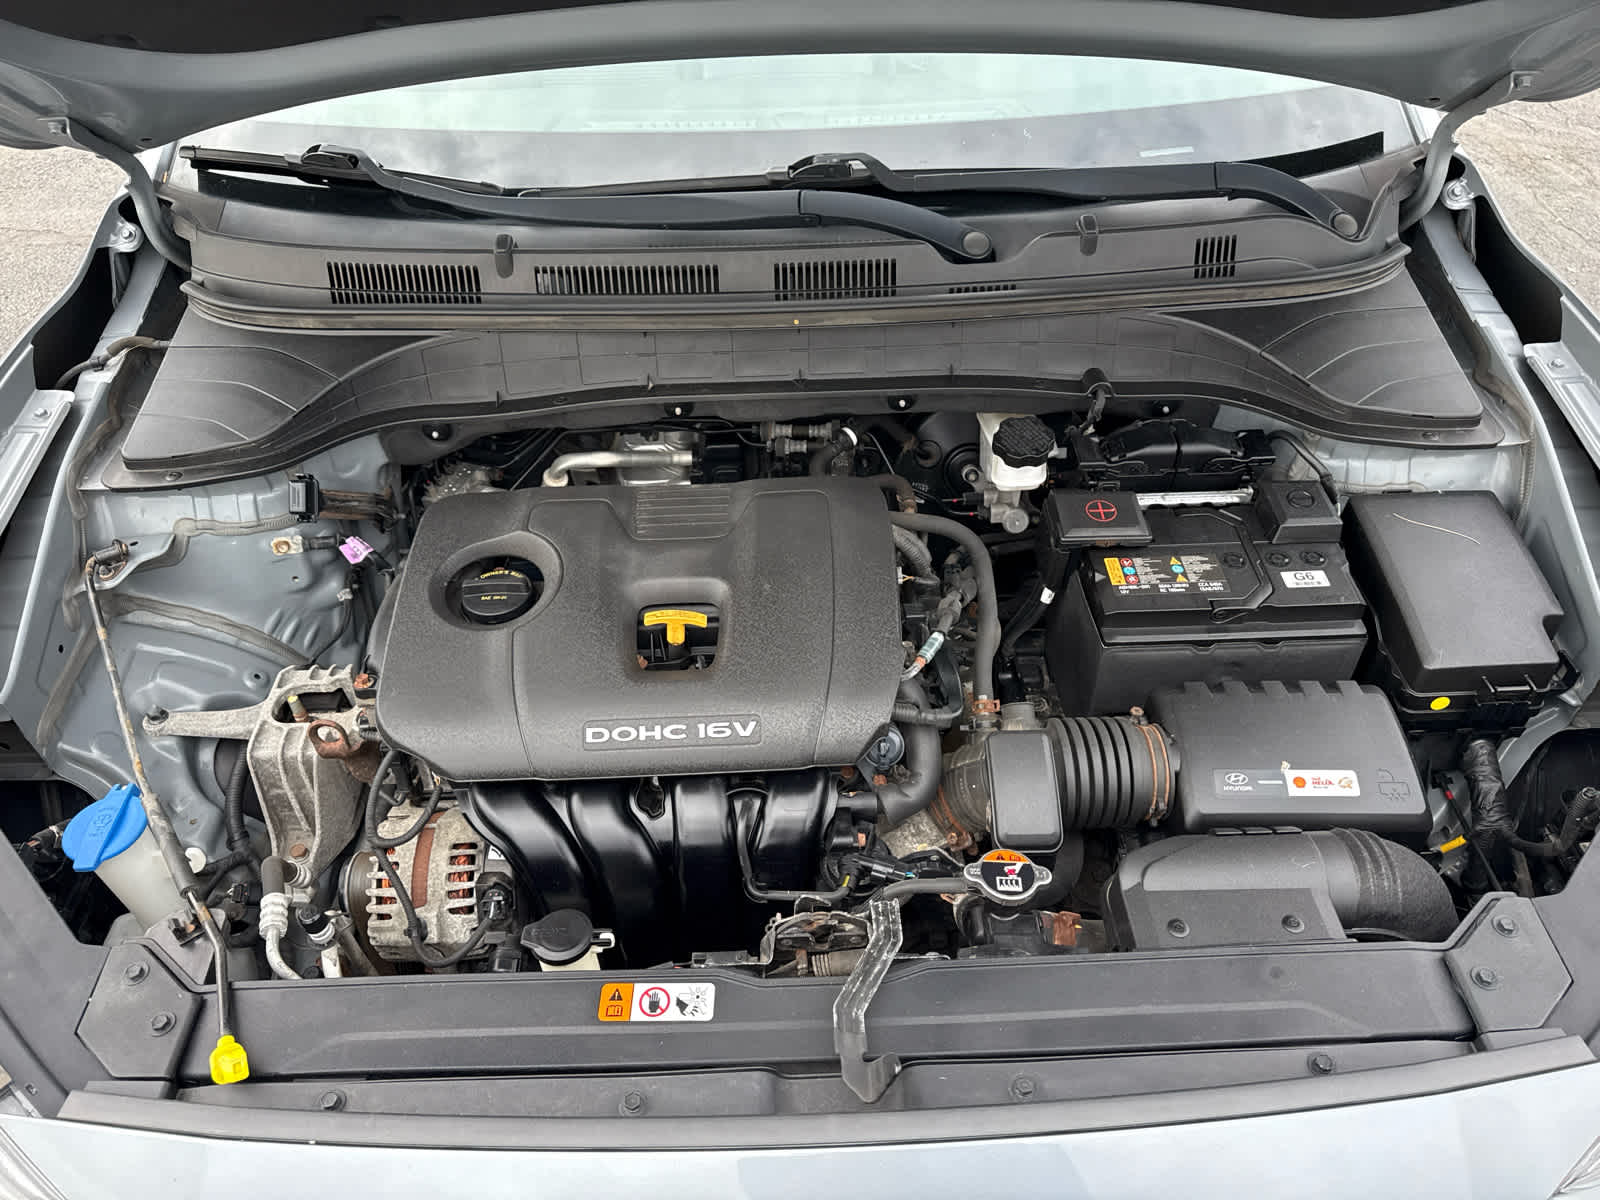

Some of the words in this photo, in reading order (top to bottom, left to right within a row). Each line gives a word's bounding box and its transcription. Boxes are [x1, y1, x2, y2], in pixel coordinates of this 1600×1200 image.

[1293, 572, 1315, 581] G6
[585, 724, 688, 743] DOHC
[697, 721, 757, 739] 16V
